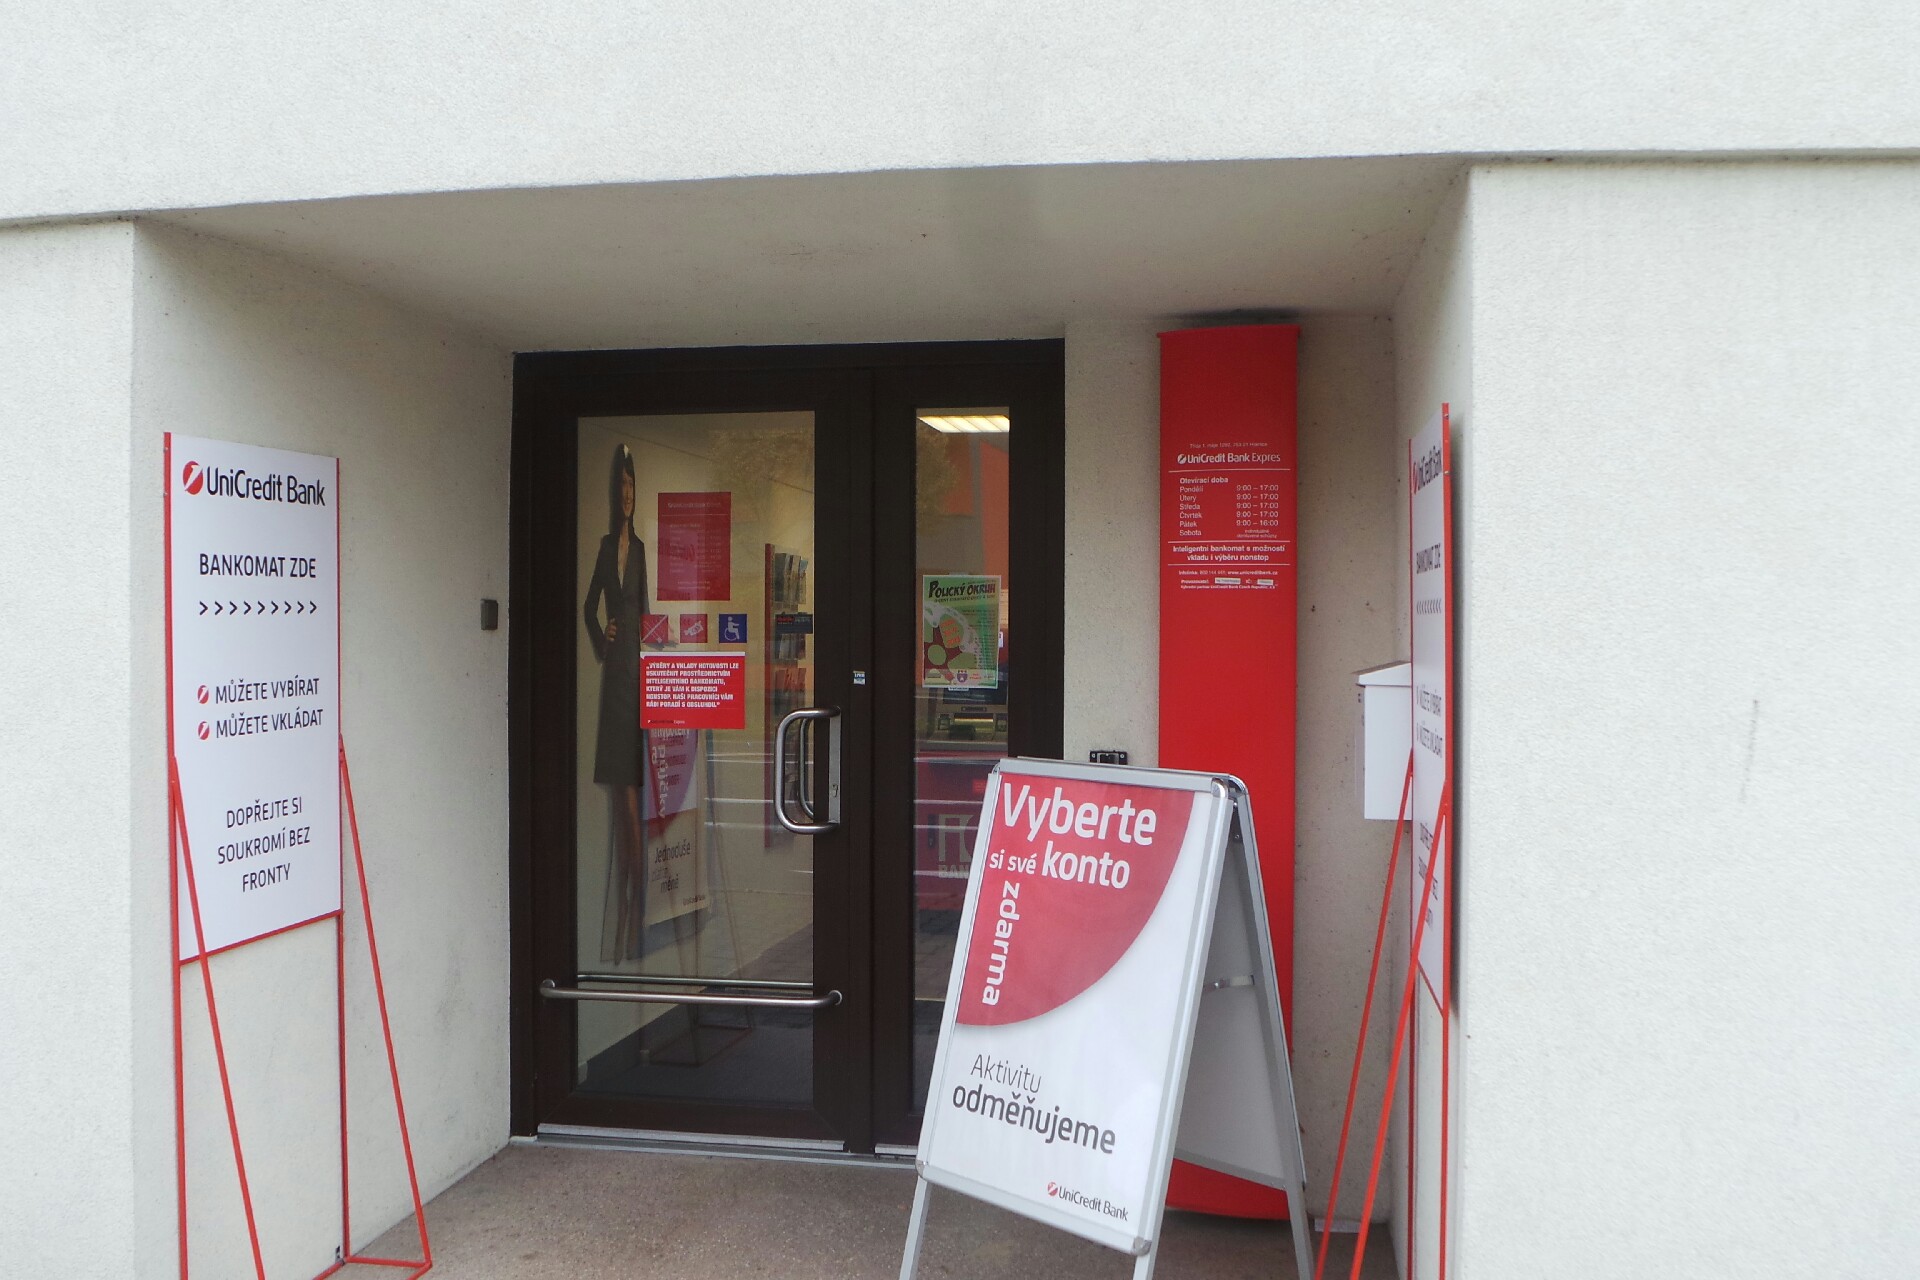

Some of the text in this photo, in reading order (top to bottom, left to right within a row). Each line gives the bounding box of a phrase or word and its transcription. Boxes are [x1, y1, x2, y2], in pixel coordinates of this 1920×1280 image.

[1187, 452, 1281, 465] UniCredit Bank Expres
[206, 466, 326, 506] UniCredit Bank
[1211, 476, 1228, 484] doba
[1180, 511, 1202, 519] Čtvrtek
[1180, 520, 1198, 528] Pátek
[1173, 545, 1209, 553] Inteligentní
[1252, 544, 1285, 552] možností
[1214, 554, 1238, 562] výběru
[200, 553, 316, 579] BANKOMAT ZDE
[216, 674, 319, 704] MŮŽETE VYBÍRAT
[216, 706, 323, 739] MŮŽETE VKLÁDAT
[227, 797, 302, 829] DOPŘEJTE SI
[1003, 782, 1157, 846] Vyberte
[218, 826, 310, 865] SOUKROMÍ BEZ
[242, 863, 291, 892] FRONTY
[989, 840, 1130, 889] si své konto
[982, 880, 1020, 1006] zdarma
[970, 1054, 1042, 1094] Aktivitu
[952, 1083, 1116, 1154] odměňujeme
[1058, 1185, 1129, 1222] UniCredit Bank
